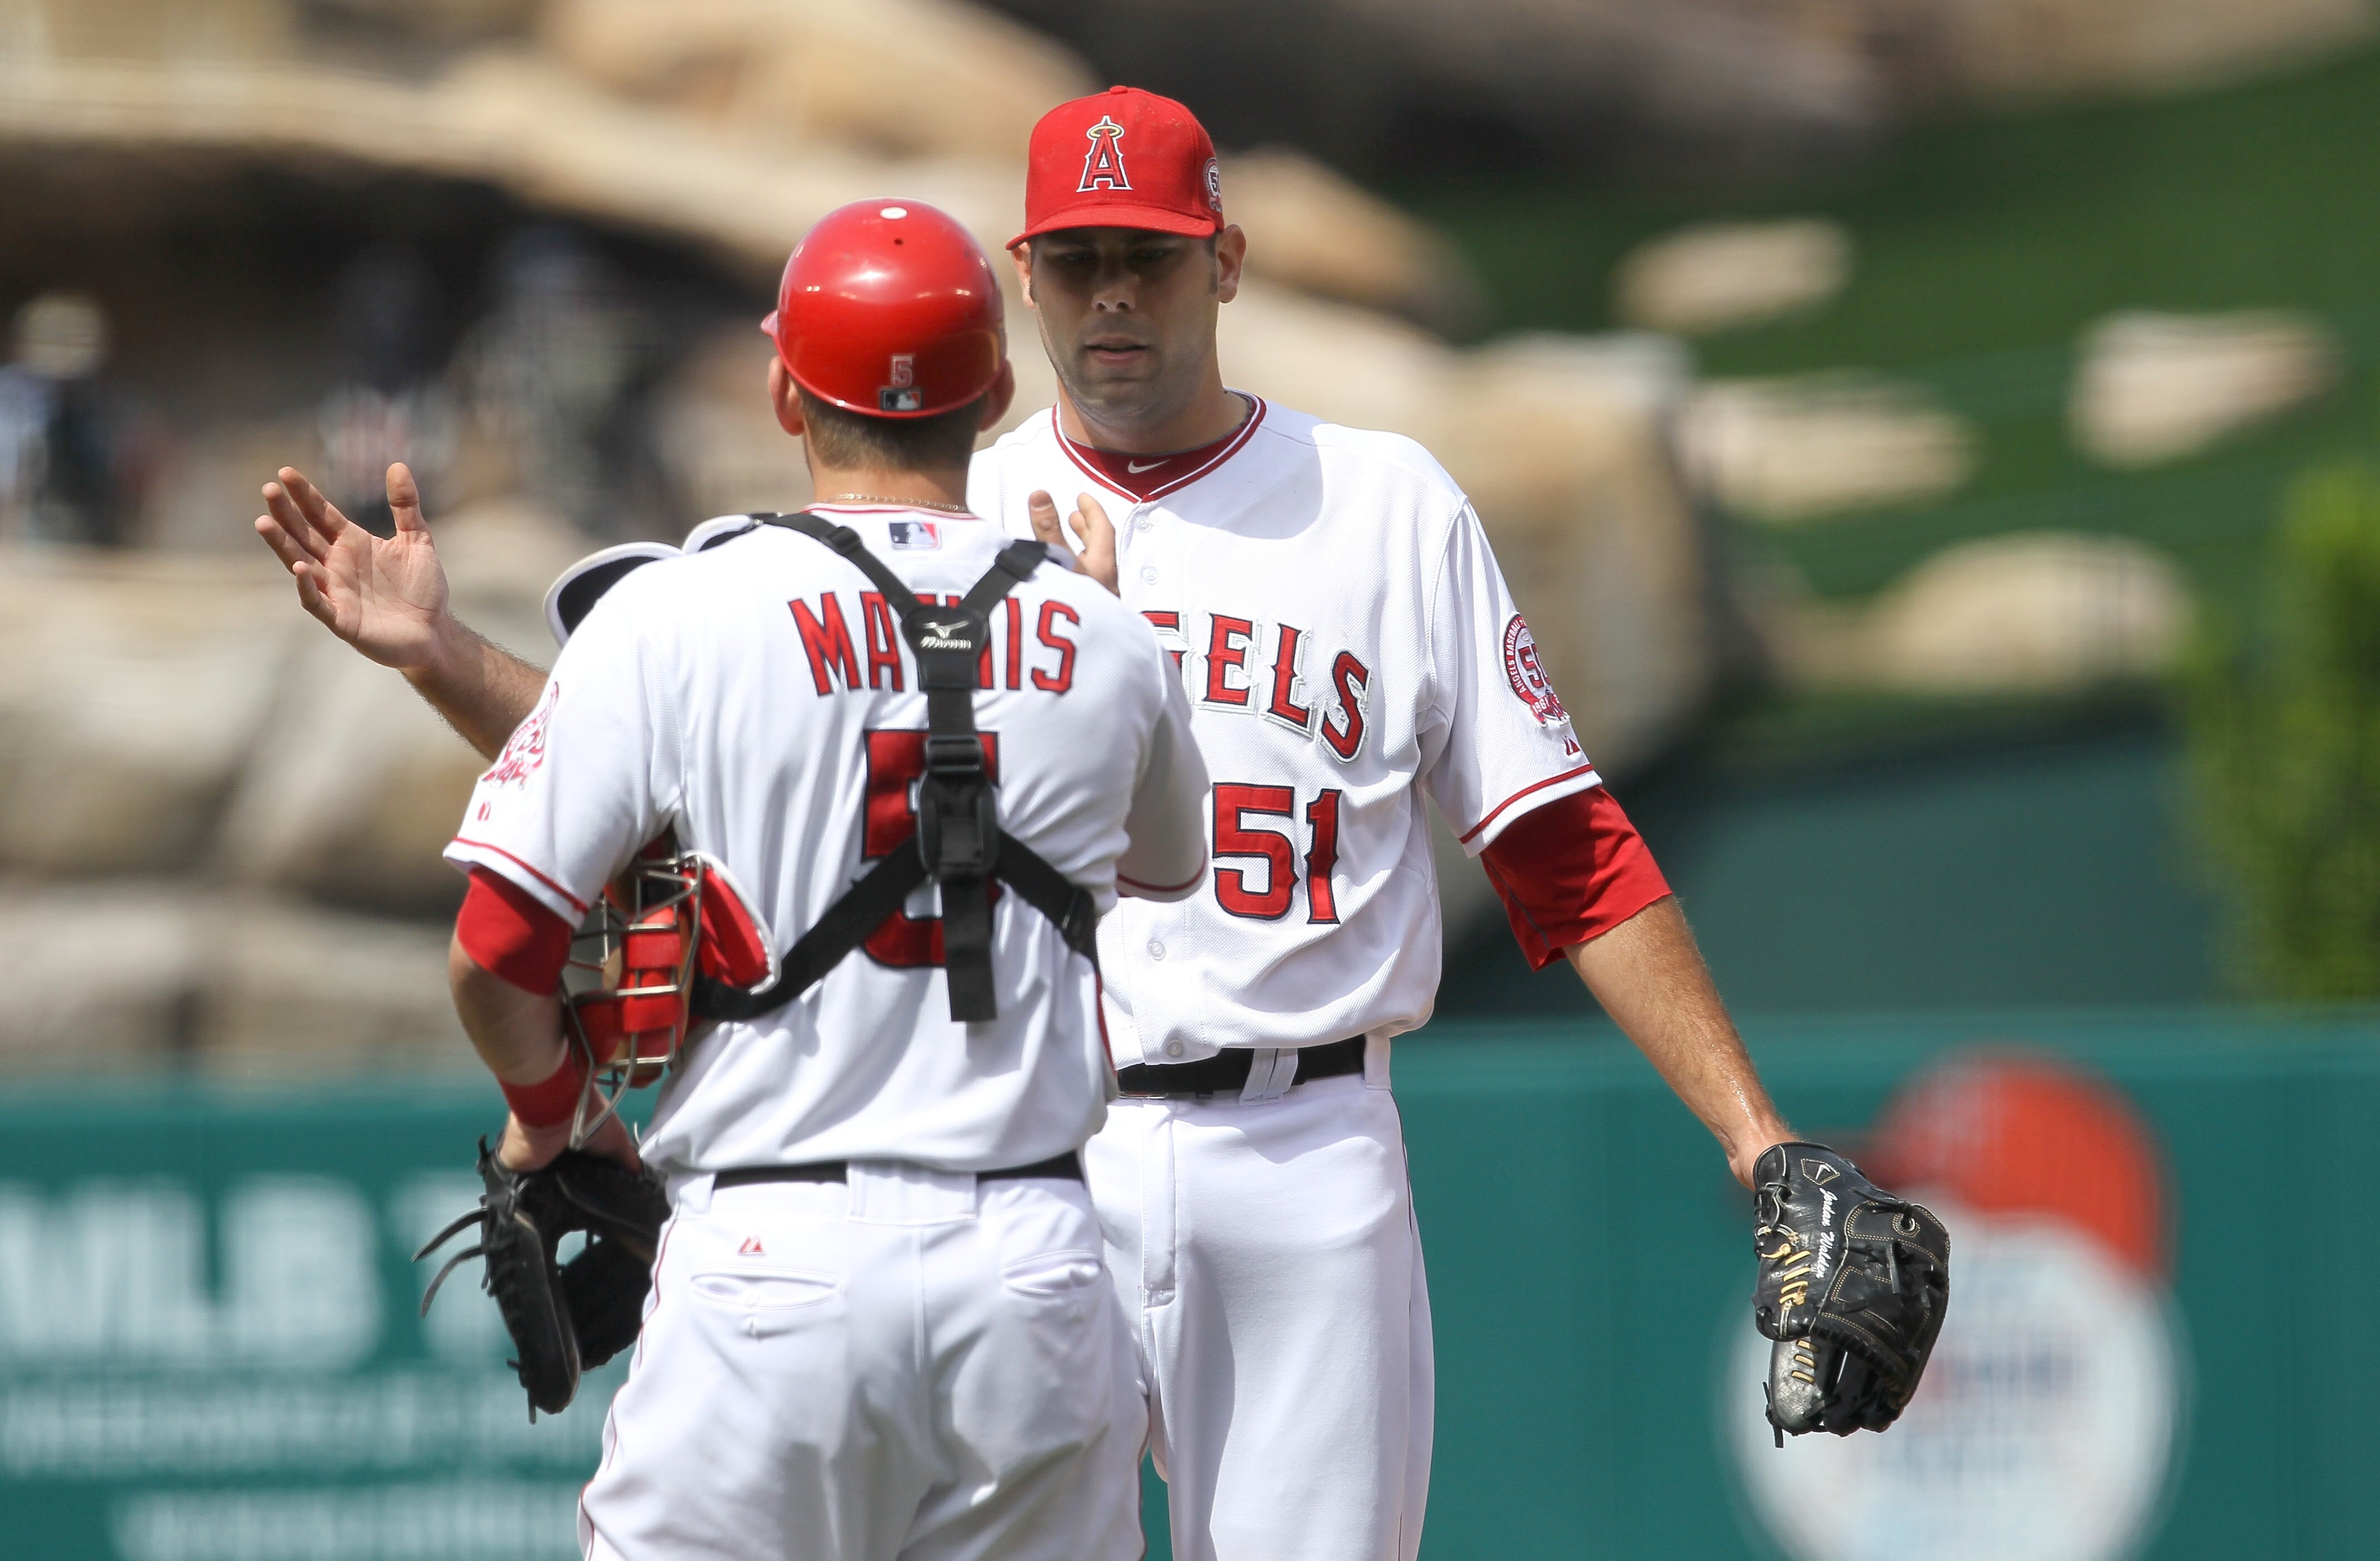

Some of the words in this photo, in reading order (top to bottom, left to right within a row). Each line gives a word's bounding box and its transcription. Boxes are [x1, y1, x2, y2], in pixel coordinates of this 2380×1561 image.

[1076, 115, 1133, 192] A
[890, 354, 914, 388] 5
[788, 591, 1080, 696] MAIS
[1508, 660, 1527, 694] ANGELS
[1212, 782, 1343, 925] 51
[1815, 1231, 1836, 1279] Walden
